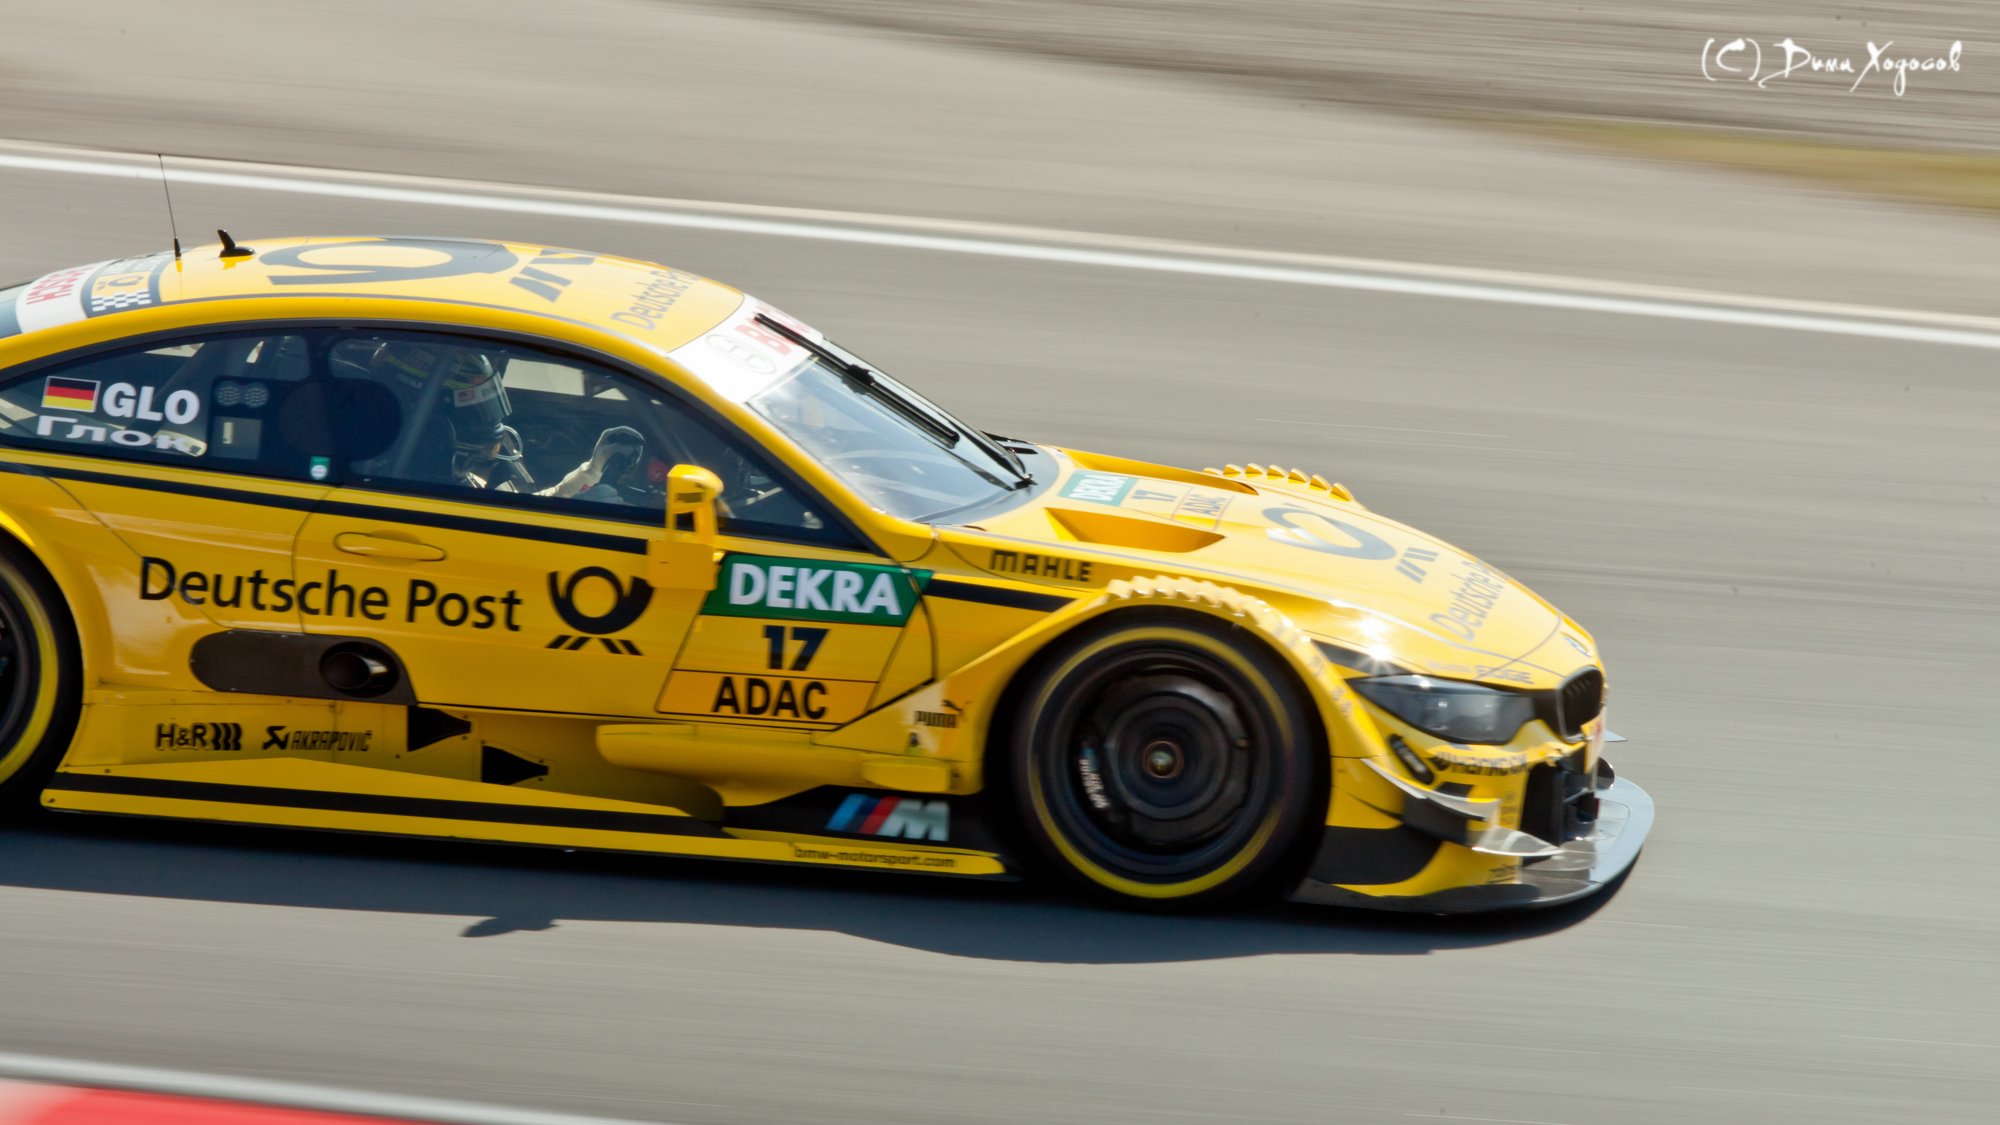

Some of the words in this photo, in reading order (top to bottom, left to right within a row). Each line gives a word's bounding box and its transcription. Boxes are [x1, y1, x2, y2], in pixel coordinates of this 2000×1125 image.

[608, 278, 689, 332] Deutsche
[102, 382, 200, 425] GLO
[1068, 474, 1129, 501] DEKRA
[990, 549, 1093, 582] MAHLE
[139, 556, 391, 621] Deutsche
[405, 579, 523, 632] Post
[728, 562, 902, 616] DEKRA
[1428, 571, 1504, 642] Deutsche
[763, 625, 830, 671] 17
[711, 677, 828, 720] ADAC
[156, 723, 208, 748] H&R
[794, 847, 956, 869] bmw-motorsport.com
